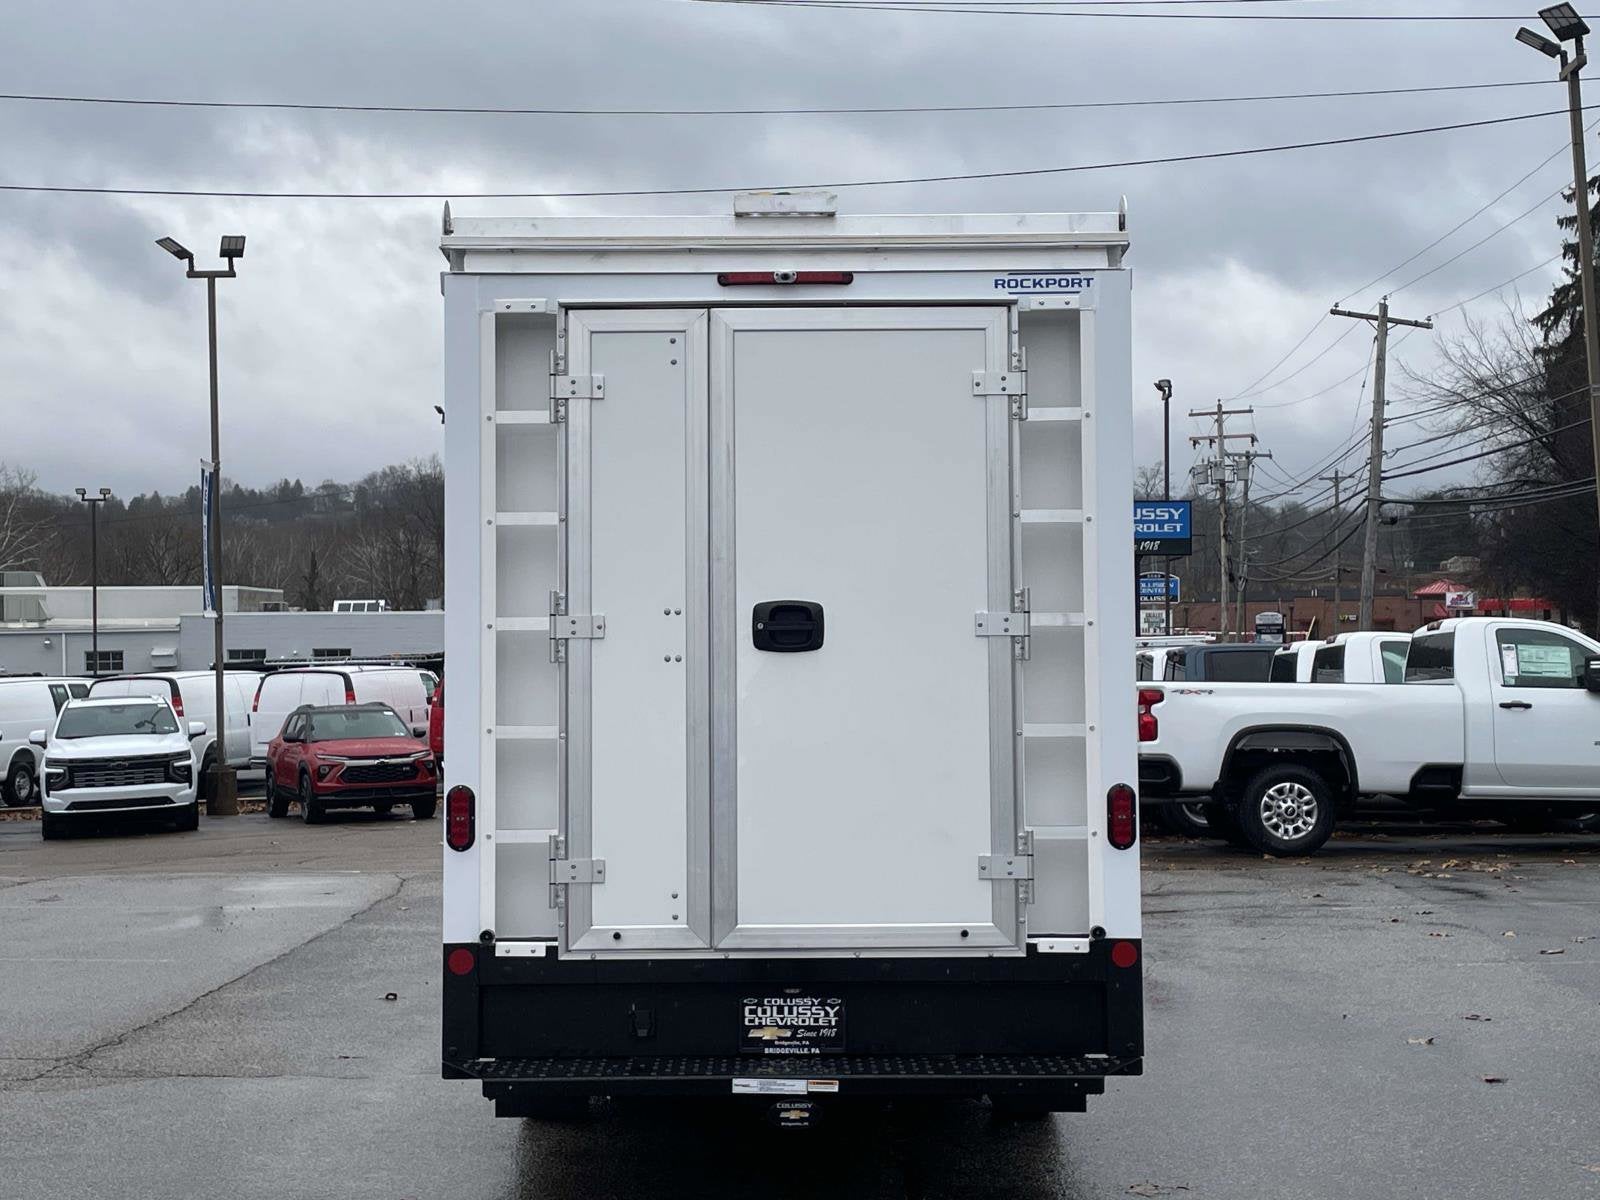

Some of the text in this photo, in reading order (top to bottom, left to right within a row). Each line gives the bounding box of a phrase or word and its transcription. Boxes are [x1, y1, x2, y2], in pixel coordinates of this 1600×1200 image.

[994, 278, 1094, 288] ROCKPORT
[1134, 508, 1184, 519] USSY
[1134, 523, 1183, 532] ROLET
[1140, 541, 1160, 550] 1918
[744, 1006, 840, 1017] COLUSSY
[744, 1017, 839, 1026] CHEVROLET
[796, 1028, 837, 1037] Since 1918
